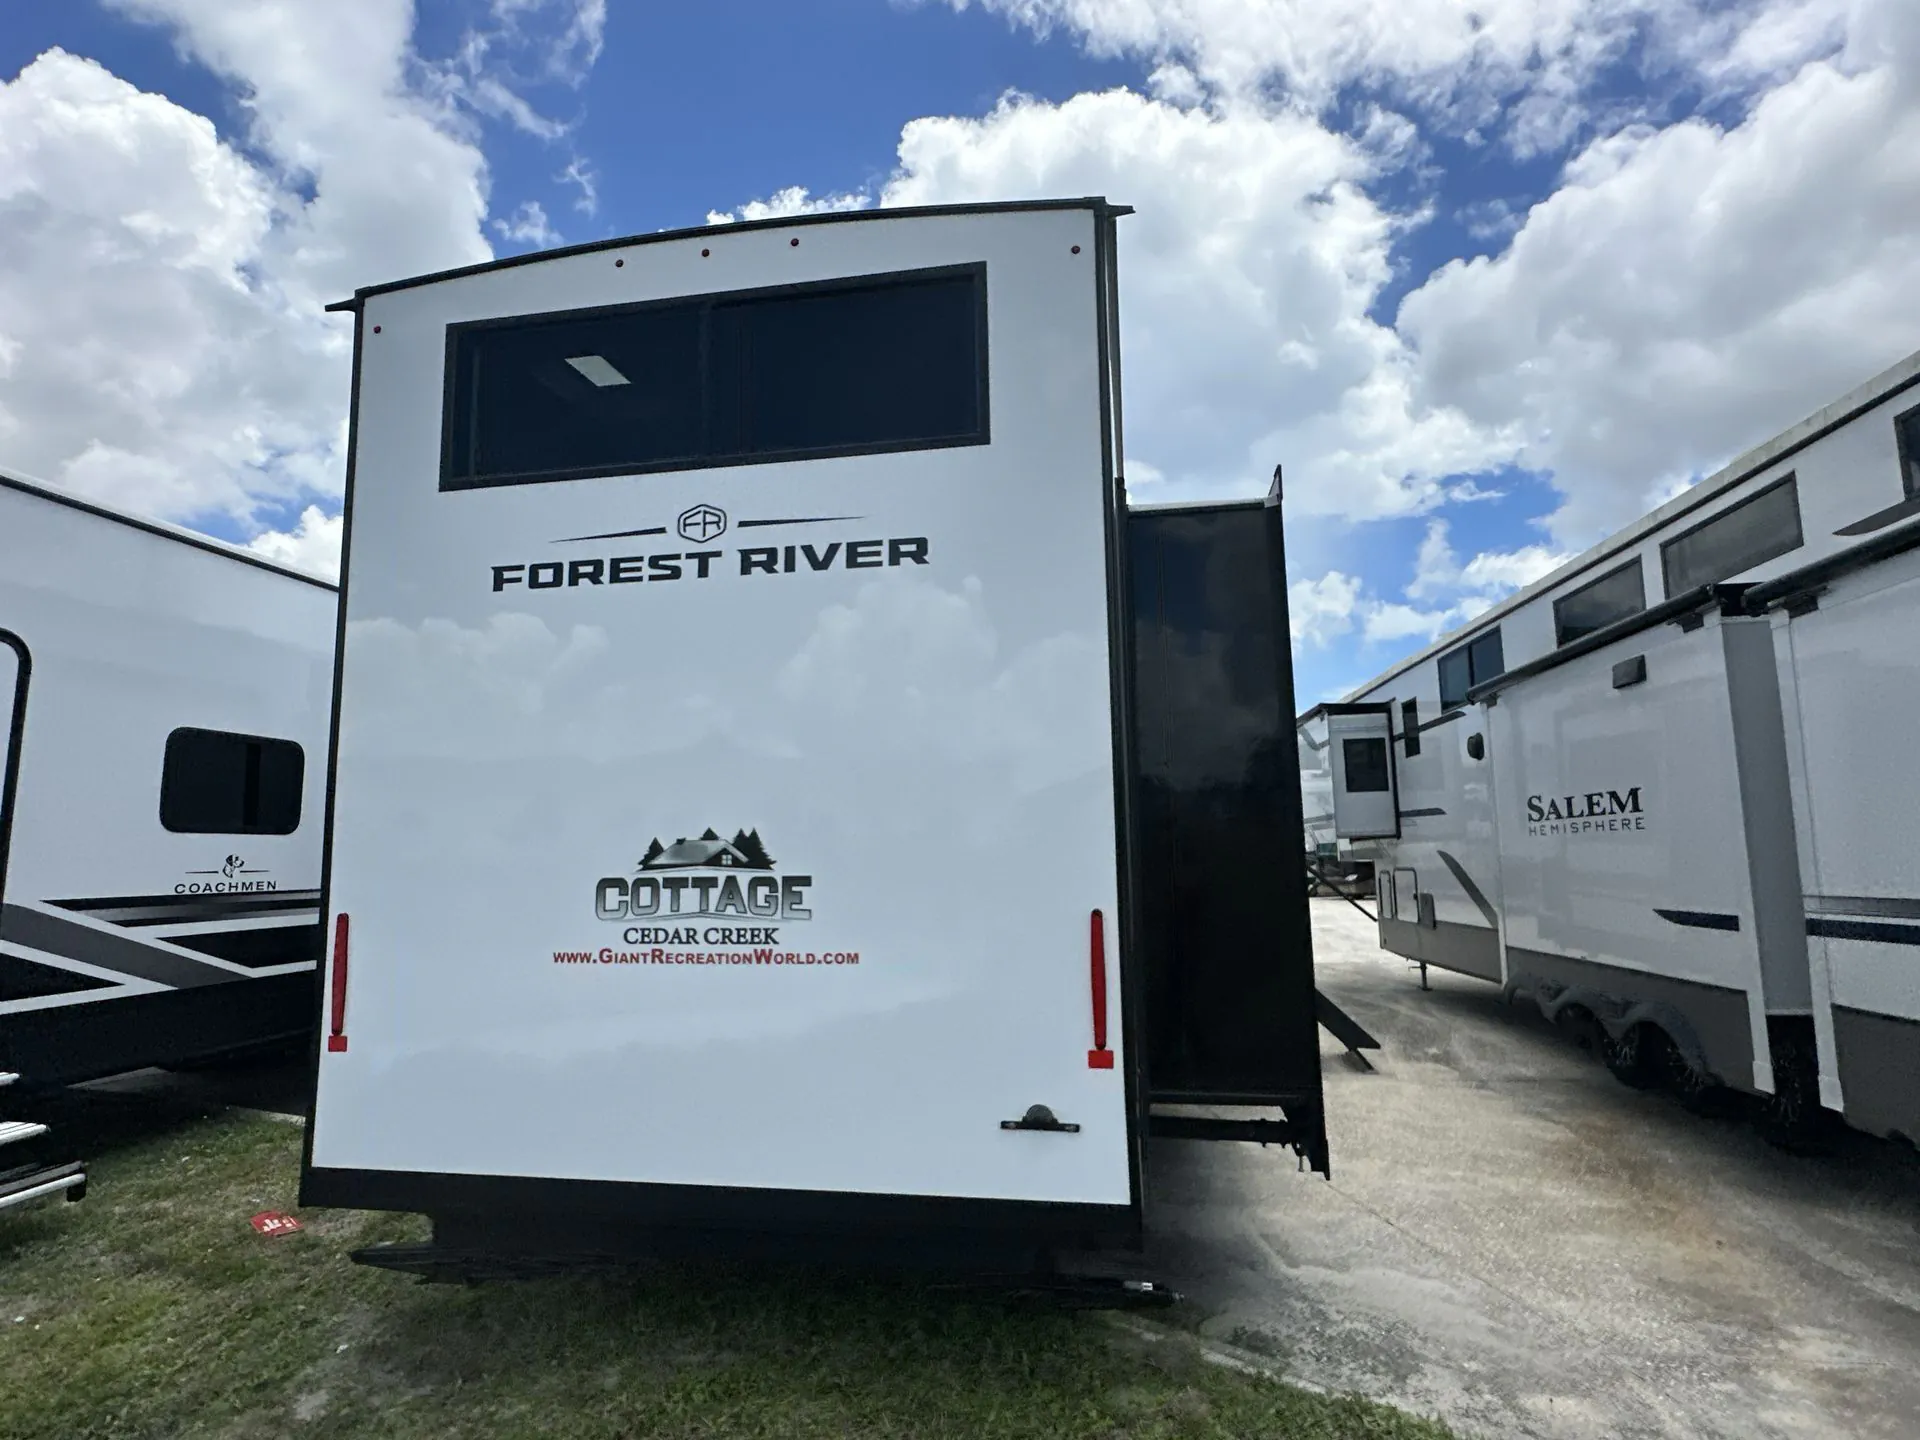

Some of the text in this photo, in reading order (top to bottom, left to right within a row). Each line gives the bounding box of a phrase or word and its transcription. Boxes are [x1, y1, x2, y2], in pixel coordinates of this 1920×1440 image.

[491, 537, 930, 592] FOREST RIVER
[1527, 787, 1643, 822] SALEM
[1528, 817, 1646, 836] HEMISPHERE
[174, 881, 277, 894] COACHMEN
[595, 875, 812, 920] COTTAGE
[623, 927, 779, 945] CEDAR CREEK
